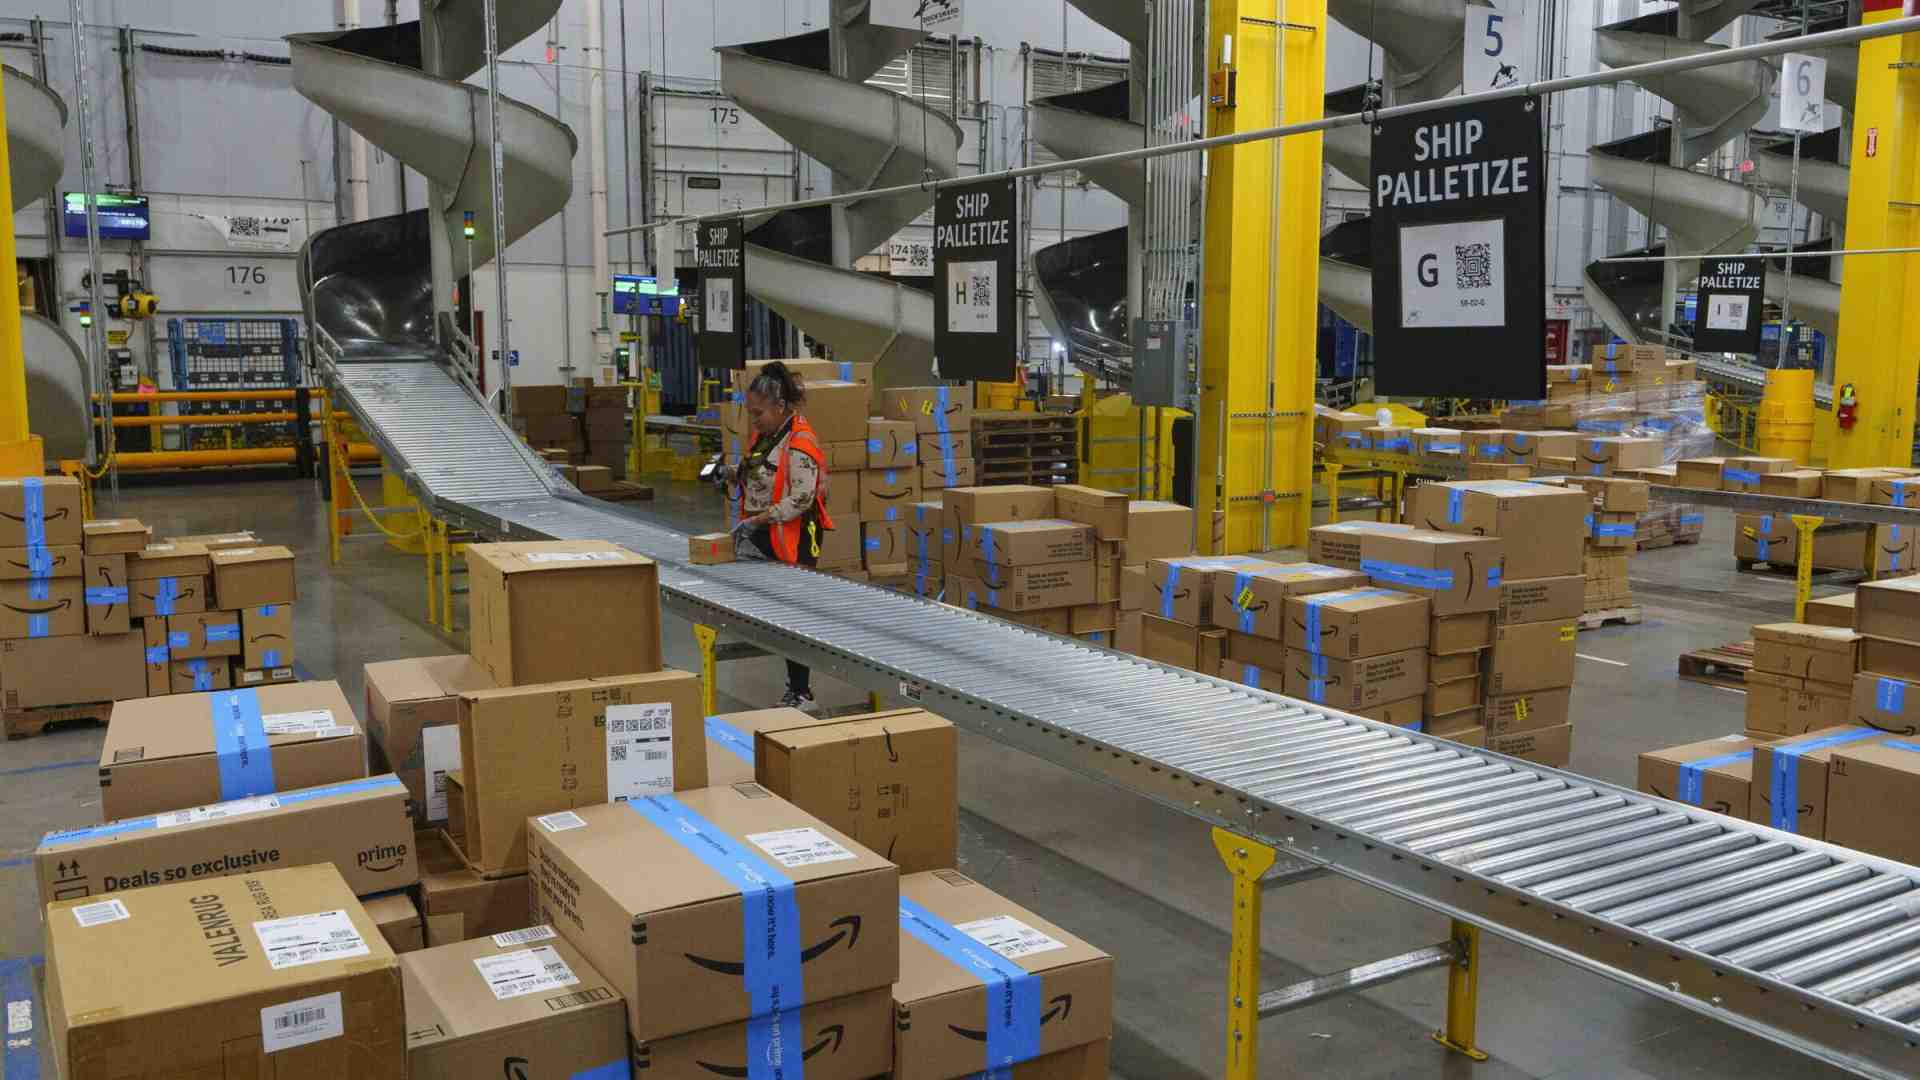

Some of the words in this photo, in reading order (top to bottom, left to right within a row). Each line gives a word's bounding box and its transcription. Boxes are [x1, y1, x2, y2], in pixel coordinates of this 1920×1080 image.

[1484, 14, 1504, 57] 5
[1797, 60, 1811, 96] 6
[710, 106, 738, 125] 175
[1414, 119, 1483, 162] SHIP
[1377, 156, 1529, 208] PALLETIZE
[956, 192, 989, 219] SHIP
[709, 226, 728, 246] SHIP
[936, 219, 1009, 249] PALLETIZE
[700, 248, 740, 268] PALLETIZE
[890, 245, 909, 256] 174
[225, 265, 266, 285] 176
[1417, 252, 1440, 288] G
[1717, 261, 1745, 275] SHIP
[956, 281, 967, 305] H
[1701, 275, 1761, 289] PALLETIZE
[356, 843, 408, 867] prime
[103, 867, 161, 893] Deals
[165, 863, 187, 881] so
[191, 847, 282, 877] exclusive
[189, 893, 249, 968] VALENRUG
